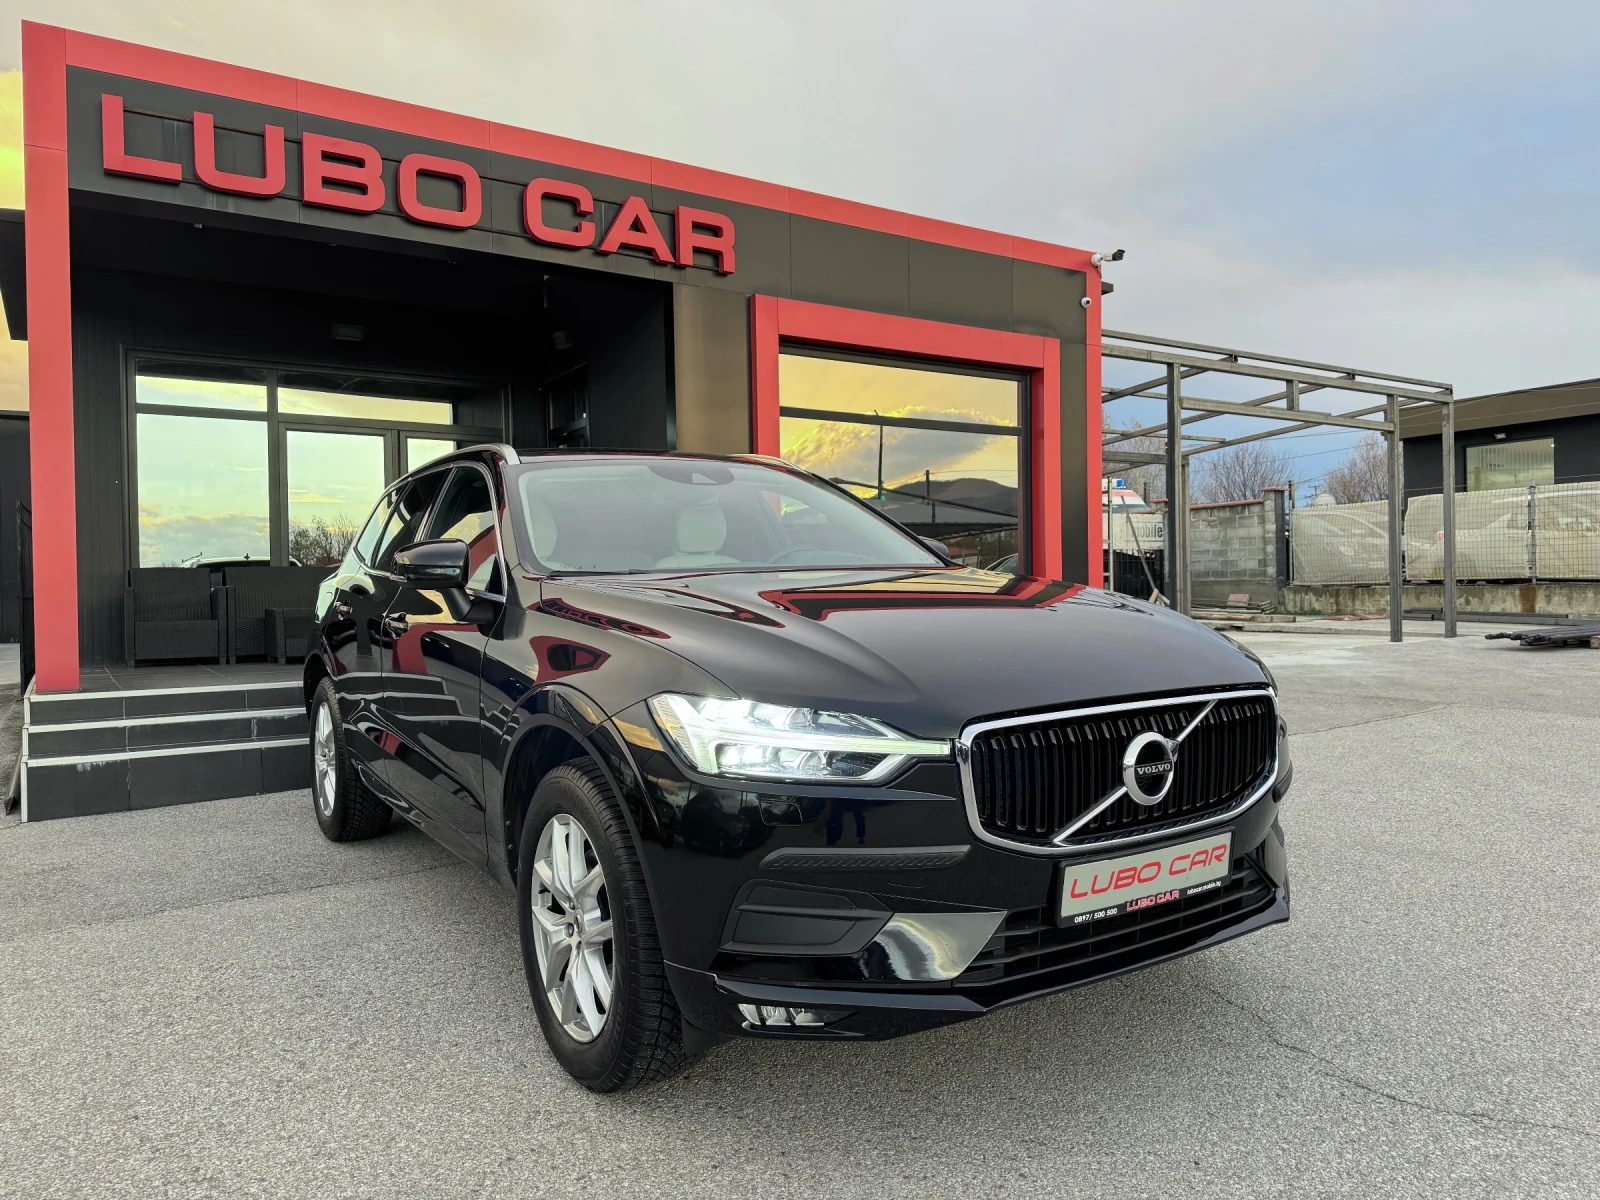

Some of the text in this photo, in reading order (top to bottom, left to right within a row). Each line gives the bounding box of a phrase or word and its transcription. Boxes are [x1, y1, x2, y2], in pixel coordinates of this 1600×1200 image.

[101, 93, 736, 276] LUBO CAR
[1136, 763, 1171, 775] VOLVO
[1070, 844, 1227, 898] LUBO CAR
[1126, 890, 1180, 912] LUBO CAR
[1094, 910, 1105, 919] 500
[1106, 907, 1118, 917] 500
